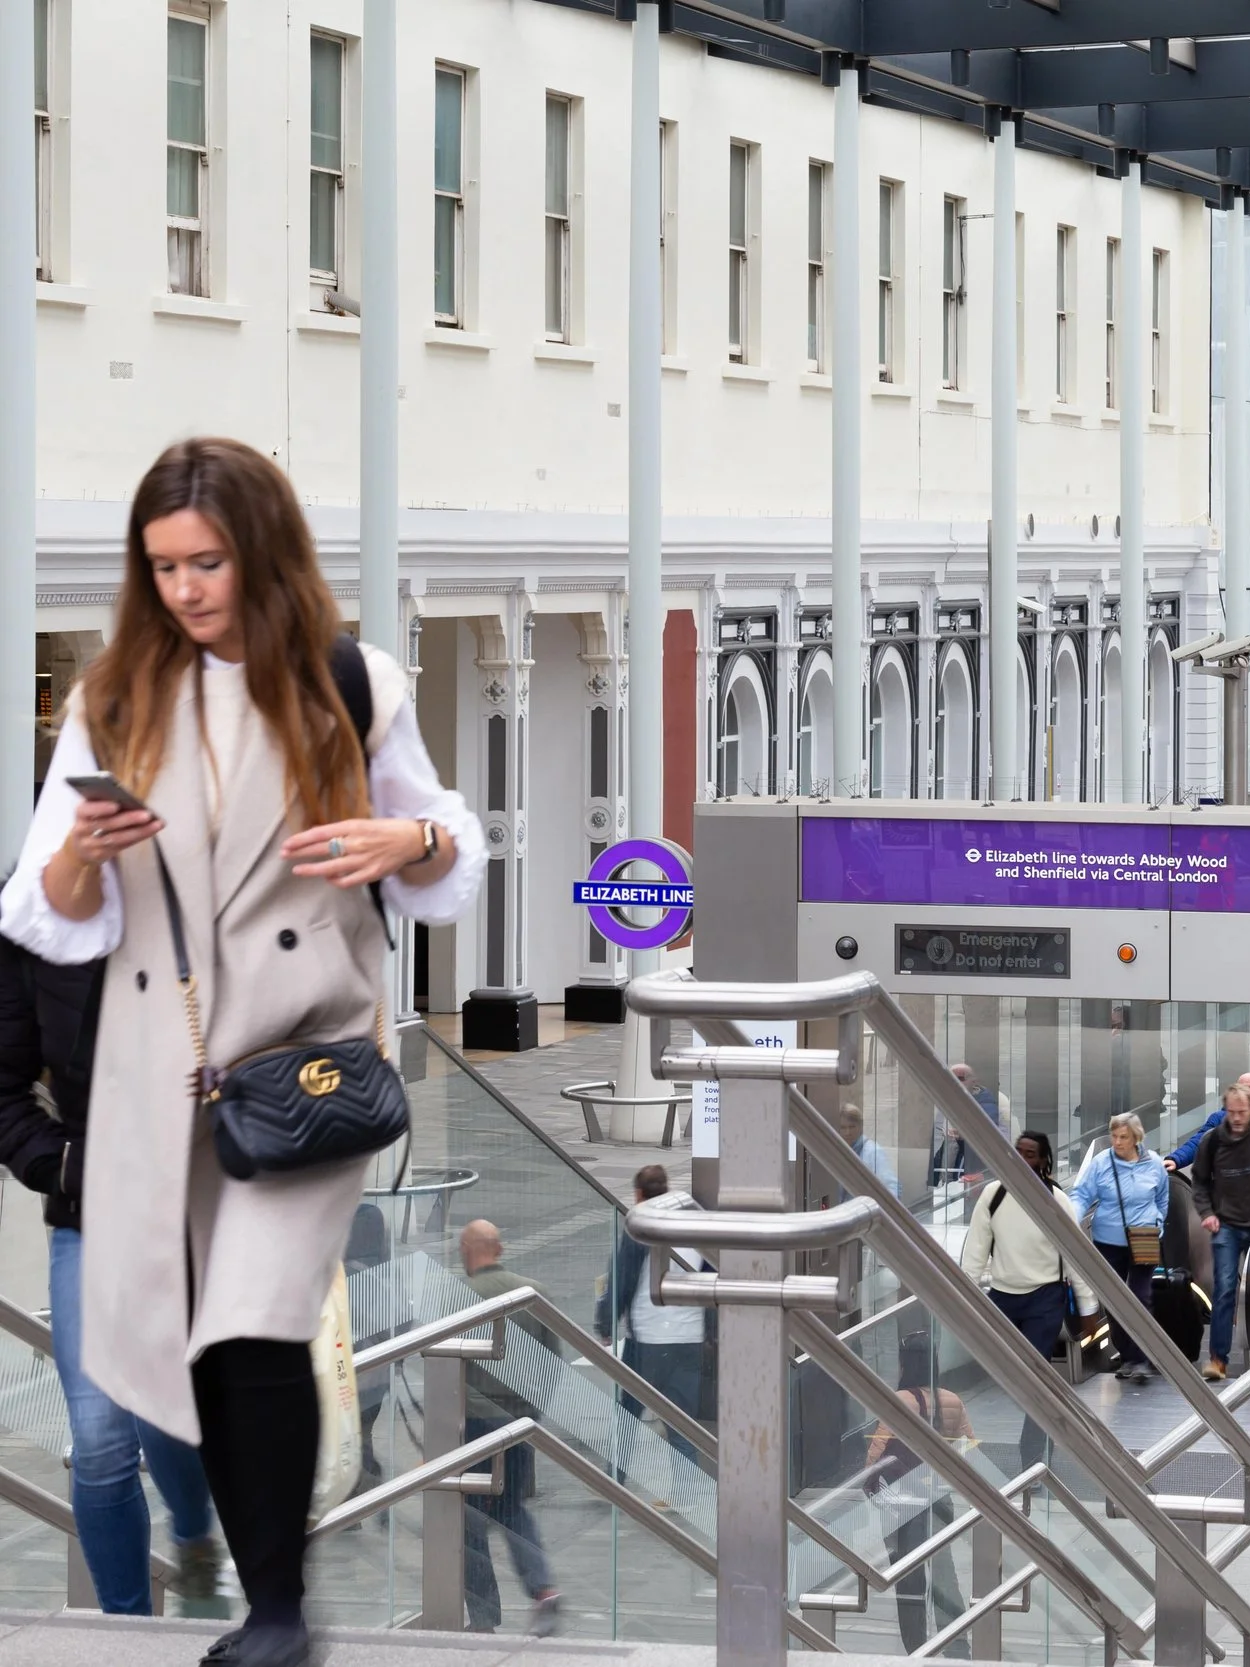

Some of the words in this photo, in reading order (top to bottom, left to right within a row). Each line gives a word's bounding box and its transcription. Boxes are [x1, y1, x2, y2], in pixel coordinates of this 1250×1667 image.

[985, 850, 1048, 864] Elizabeth
[1052, 851, 1077, 864] line
[1081, 853, 1136, 866] towards
[1139, 854, 1183, 870] Abbey
[1187, 855, 1228, 868] Wood
[995, 866, 1020, 878] and
[1023, 866, 1087, 880] Shenfield
[1091, 868, 1110, 880] via
[1113, 868, 1164, 882] Central
[1168, 870, 1218, 883] London
[581, 887, 658, 902] ELIZABETH
[662, 889, 694, 903] LINE
[959, 932, 1038, 950] Emergency
[955, 953, 976, 966] Do
[980, 955, 1002, 967] not
[1005, 957, 1042, 968] enter
[704, 1096, 718, 1104] and
